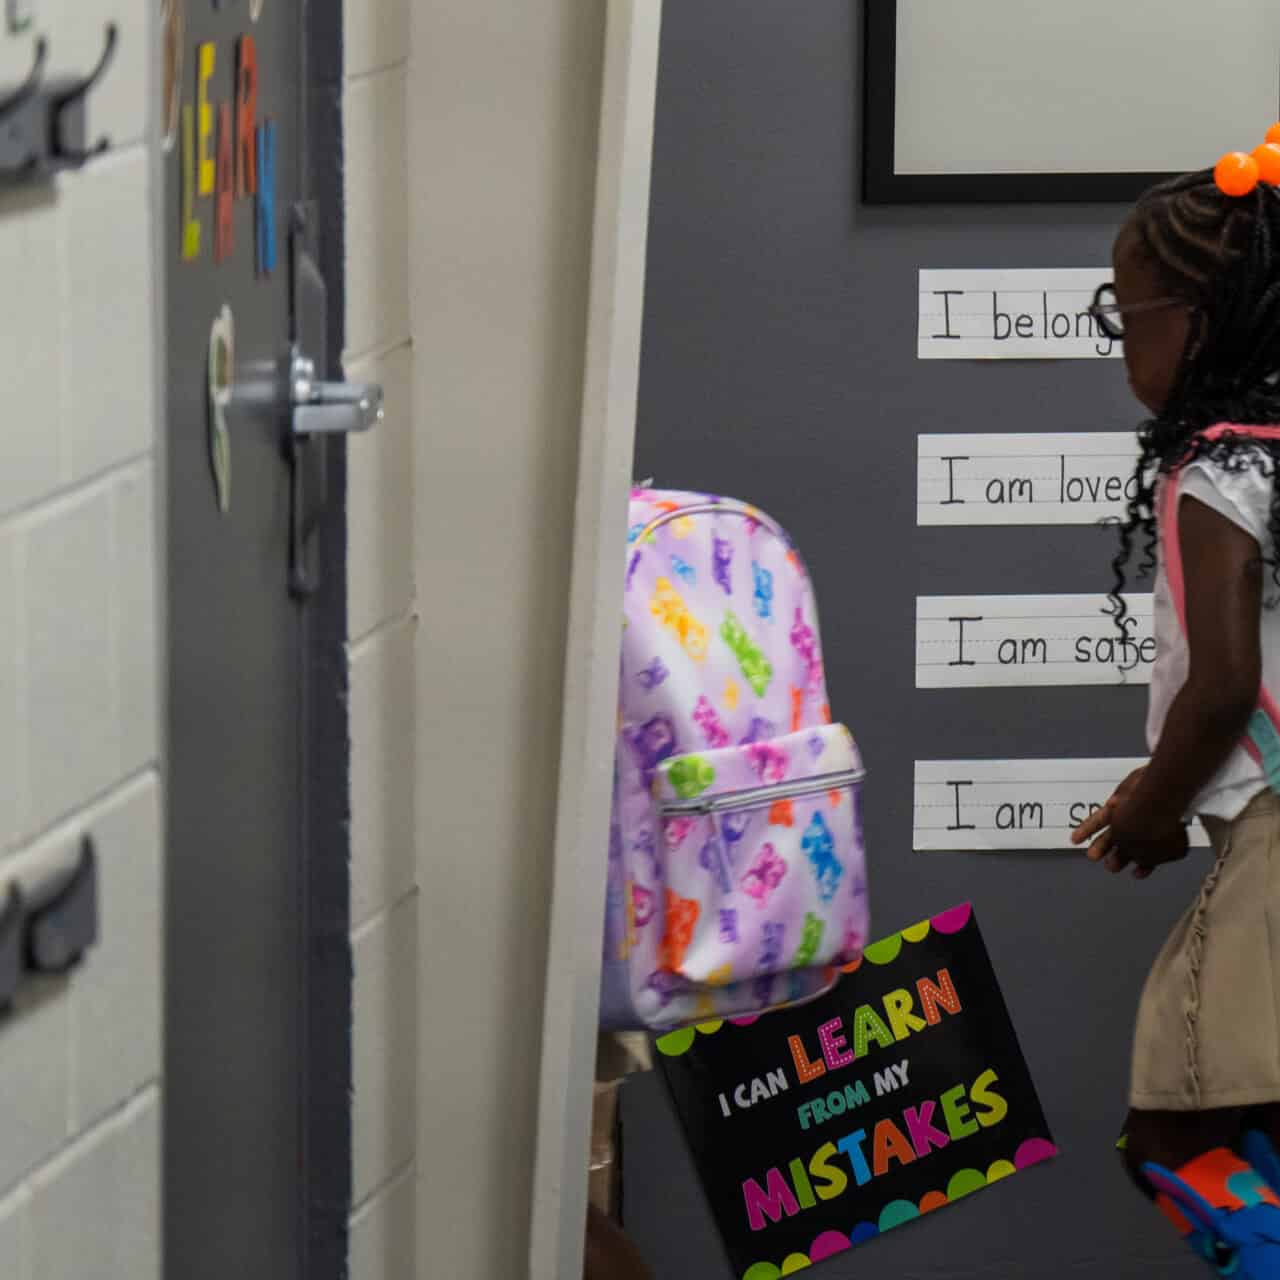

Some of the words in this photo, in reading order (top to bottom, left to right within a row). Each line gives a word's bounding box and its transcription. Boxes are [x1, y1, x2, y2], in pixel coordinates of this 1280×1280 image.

[932, 290, 965, 339] I
[939, 456, 970, 505] I
[985, 477, 1034, 505] am
[948, 616, 983, 666] I
[997, 637, 1047, 665] am
[1075, 617, 1157, 663] safe
[945, 780, 976, 831] I
[995, 802, 1044, 829] am
[717, 1093, 732, 1118] I
[734, 1068, 790, 1109] CAN
[787, 968, 962, 1084] LEARN
[796, 1080, 871, 1130] FROM
[873, 1059, 910, 1097] MY
[742, 1068, 1009, 1231] MISTAKES
